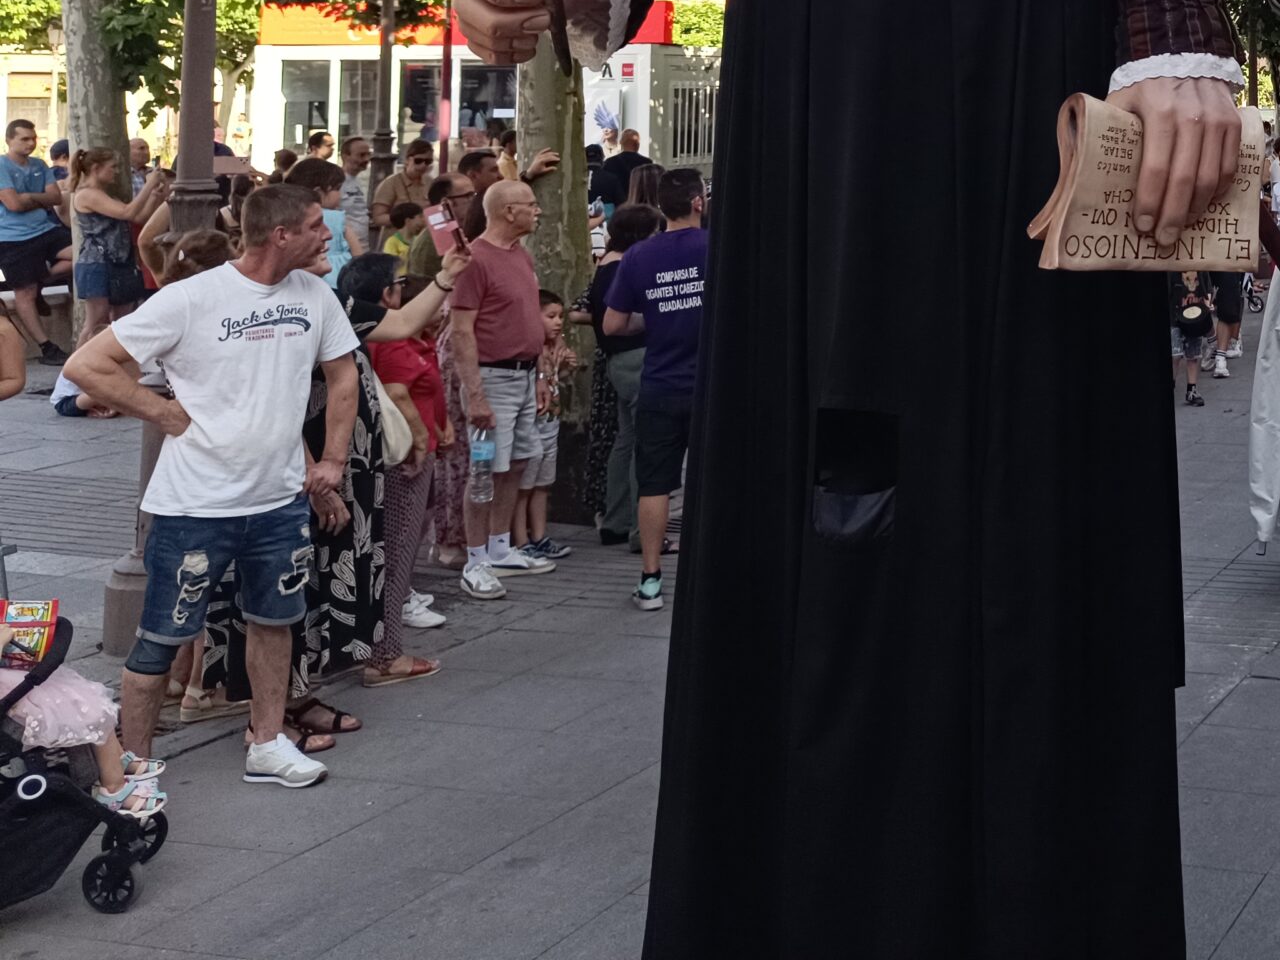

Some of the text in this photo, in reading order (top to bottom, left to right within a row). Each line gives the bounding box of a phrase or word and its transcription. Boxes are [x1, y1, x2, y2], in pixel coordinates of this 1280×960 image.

[1103, 188, 1134, 204] CHA
[1217, 239, 1251, 261] EL
[656, 266, 699, 284] COMPARSA DE
[673, 284, 679, 296] Y
[218, 304, 309, 342] Jack & Jones
[245, 333, 275, 342] TRADEMARK
